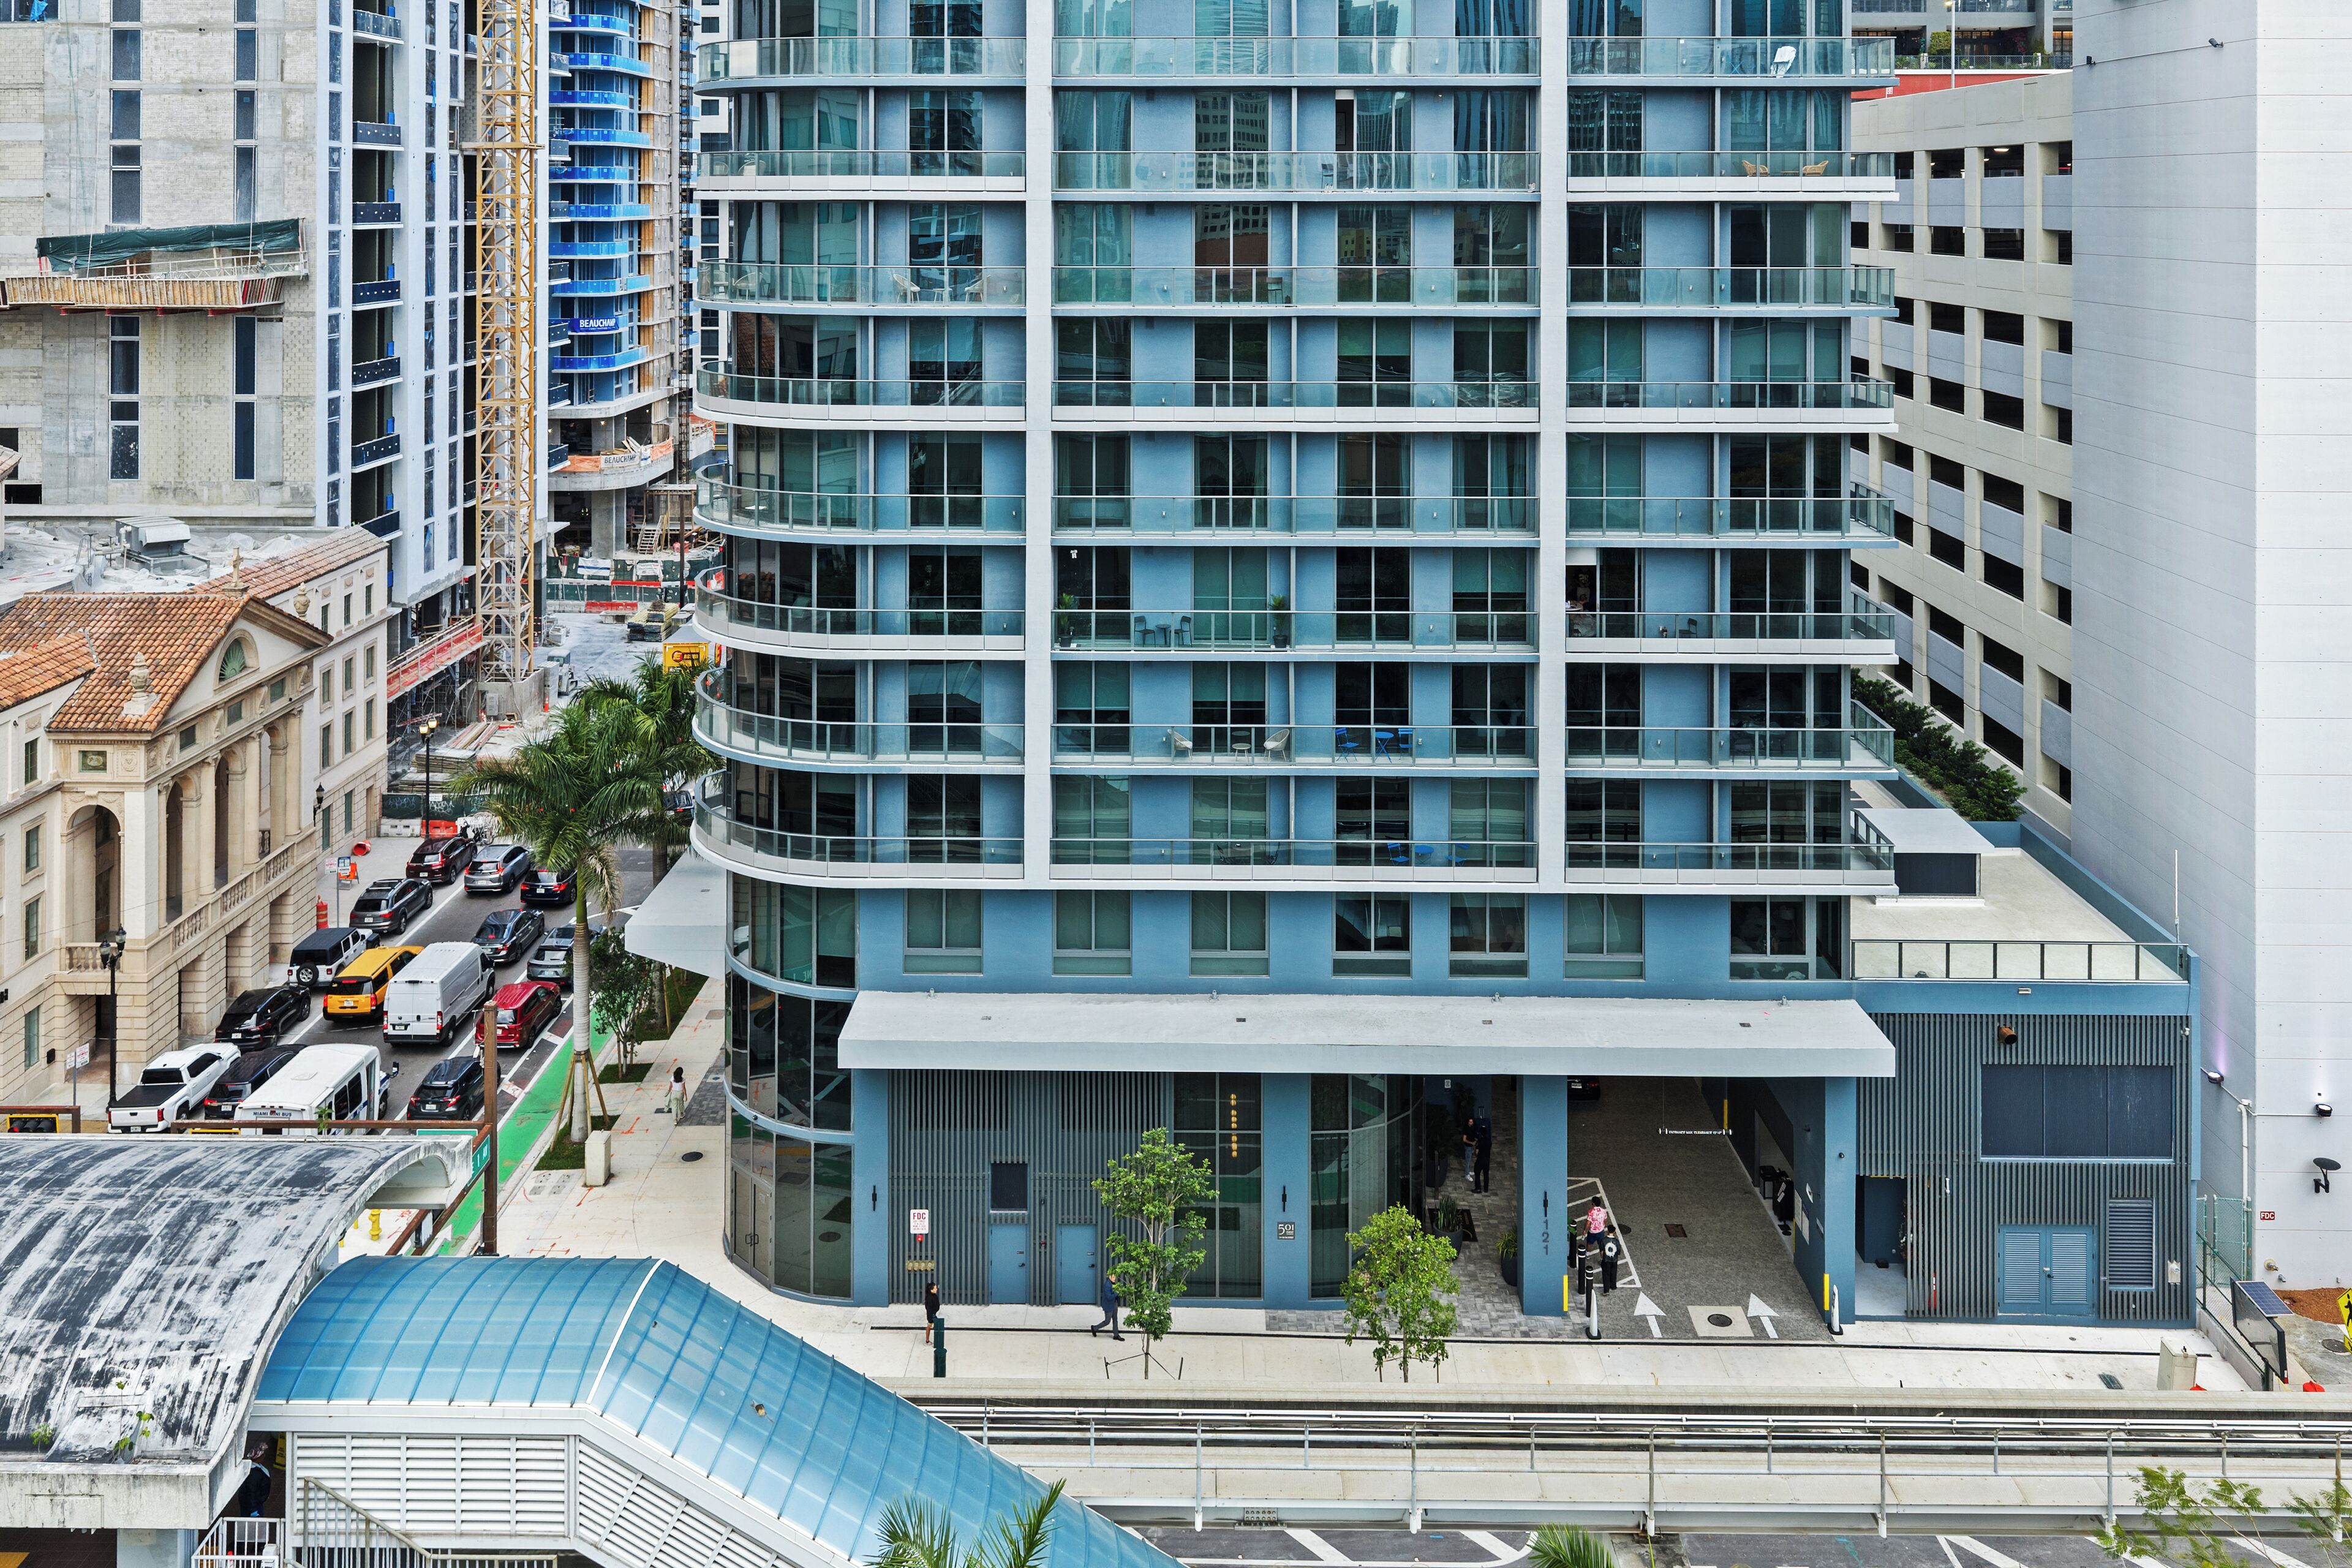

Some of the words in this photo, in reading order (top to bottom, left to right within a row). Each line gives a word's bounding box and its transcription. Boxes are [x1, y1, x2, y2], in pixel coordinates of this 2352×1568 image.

[579, 318, 616, 328] BEAUCHAMP
[605, 454, 637, 464] BEAUCHAMP
[1278, 1224, 1294, 1235] 501
